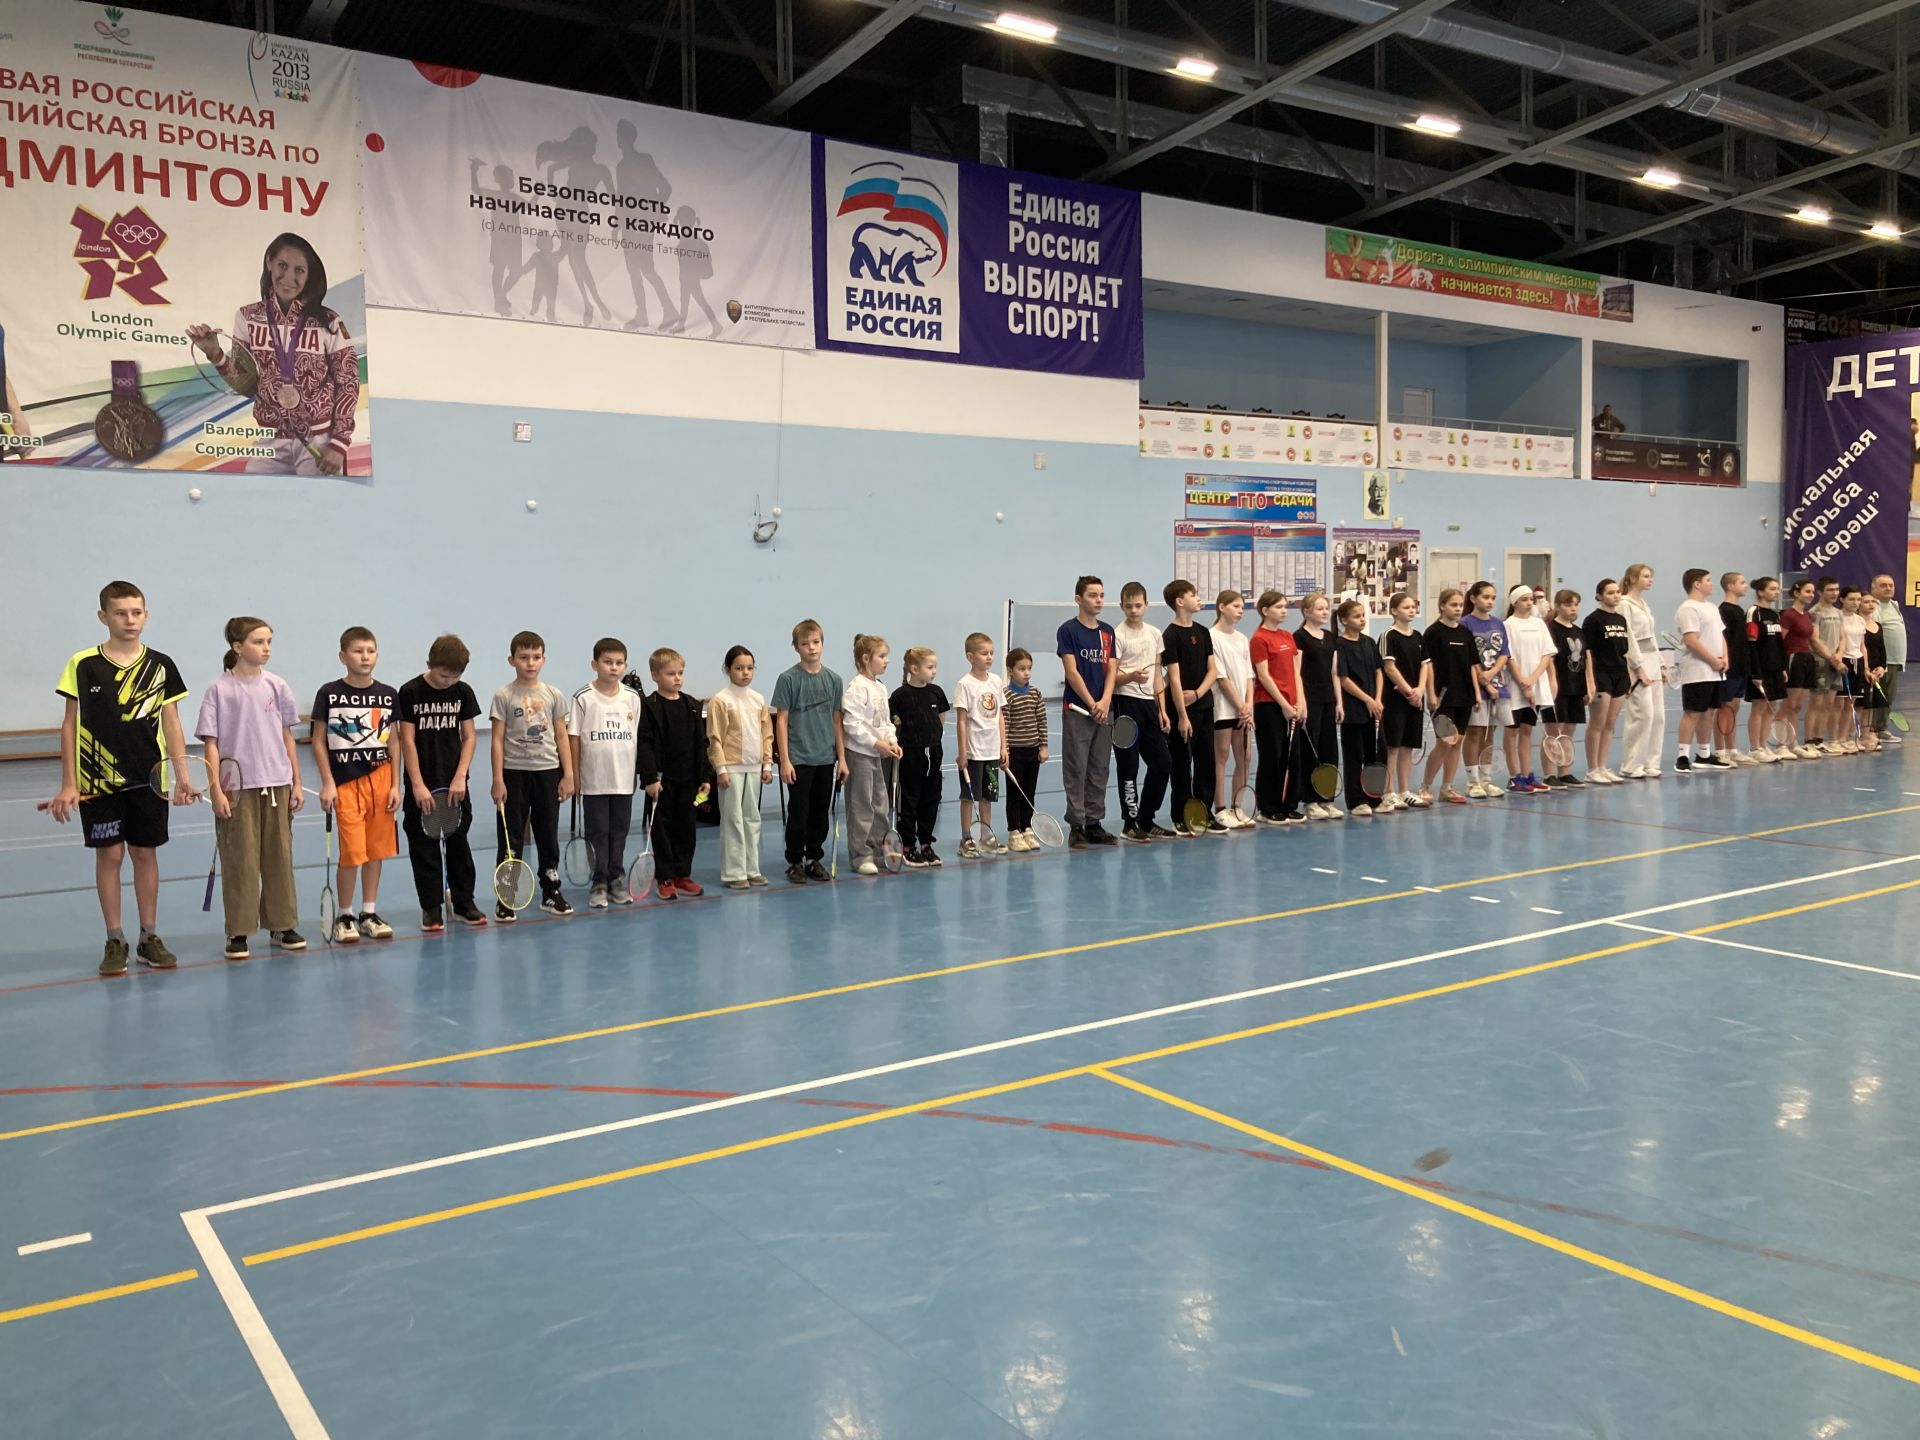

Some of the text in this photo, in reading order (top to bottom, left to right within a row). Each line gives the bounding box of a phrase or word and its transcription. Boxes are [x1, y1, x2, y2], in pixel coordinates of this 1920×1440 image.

[271, 48, 309, 63] KAZAN
[272, 60, 310, 80] 2013
[0, 67, 275, 129] ВАЯ РОССИЙСКАЯ
[272, 77, 311, 93] RUSSIA
[158, 123, 276, 160] БРОНЗА
[284, 145, 319, 164] ПО
[519, 176, 671, 215] Безопасность
[1008, 182, 1099, 229] Единая
[469, 194, 714, 242] начинается с каждого
[79, 242, 110, 253] london
[499, 222, 549, 238] Аппарат
[552, 229, 574, 242] АТК
[577, 234, 583, 243] в
[587, 234, 654, 253] Республике
[657, 243, 709, 260] Татарстан
[1008, 220, 1099, 265] Россия
[1396, 244, 1443, 265] Дорога
[1448, 256, 1454, 267] к
[1459, 258, 1542, 281] олимпийским
[984, 260, 1122, 308] ВЫБИРАЕТ
[1441, 276, 1553, 305] начинается здесь!
[846, 286, 941, 316] ЕДИНАЯ
[91, 310, 153, 327] London
[846, 310, 942, 341] РОССИЯ
[1008, 302, 1099, 343] СПОРТ!
[57, 323, 188, 345] Olympic Games
[248, 324, 319, 351] RUIA
[1827, 345, 1920, 401] ДЕТ
[205, 423, 275, 438] Валерия
[195, 443, 275, 458] Сорокина
[1189, 491, 1313, 510] ЦЕНТР ГТО СДАЧИ
[329, 694, 393, 706] PACIFIC
[413, 699, 461, 715] РЕАЛЬНЫЙ
[419, 715, 456, 731] ПАЦАН
[606, 720, 620, 729] Fly
